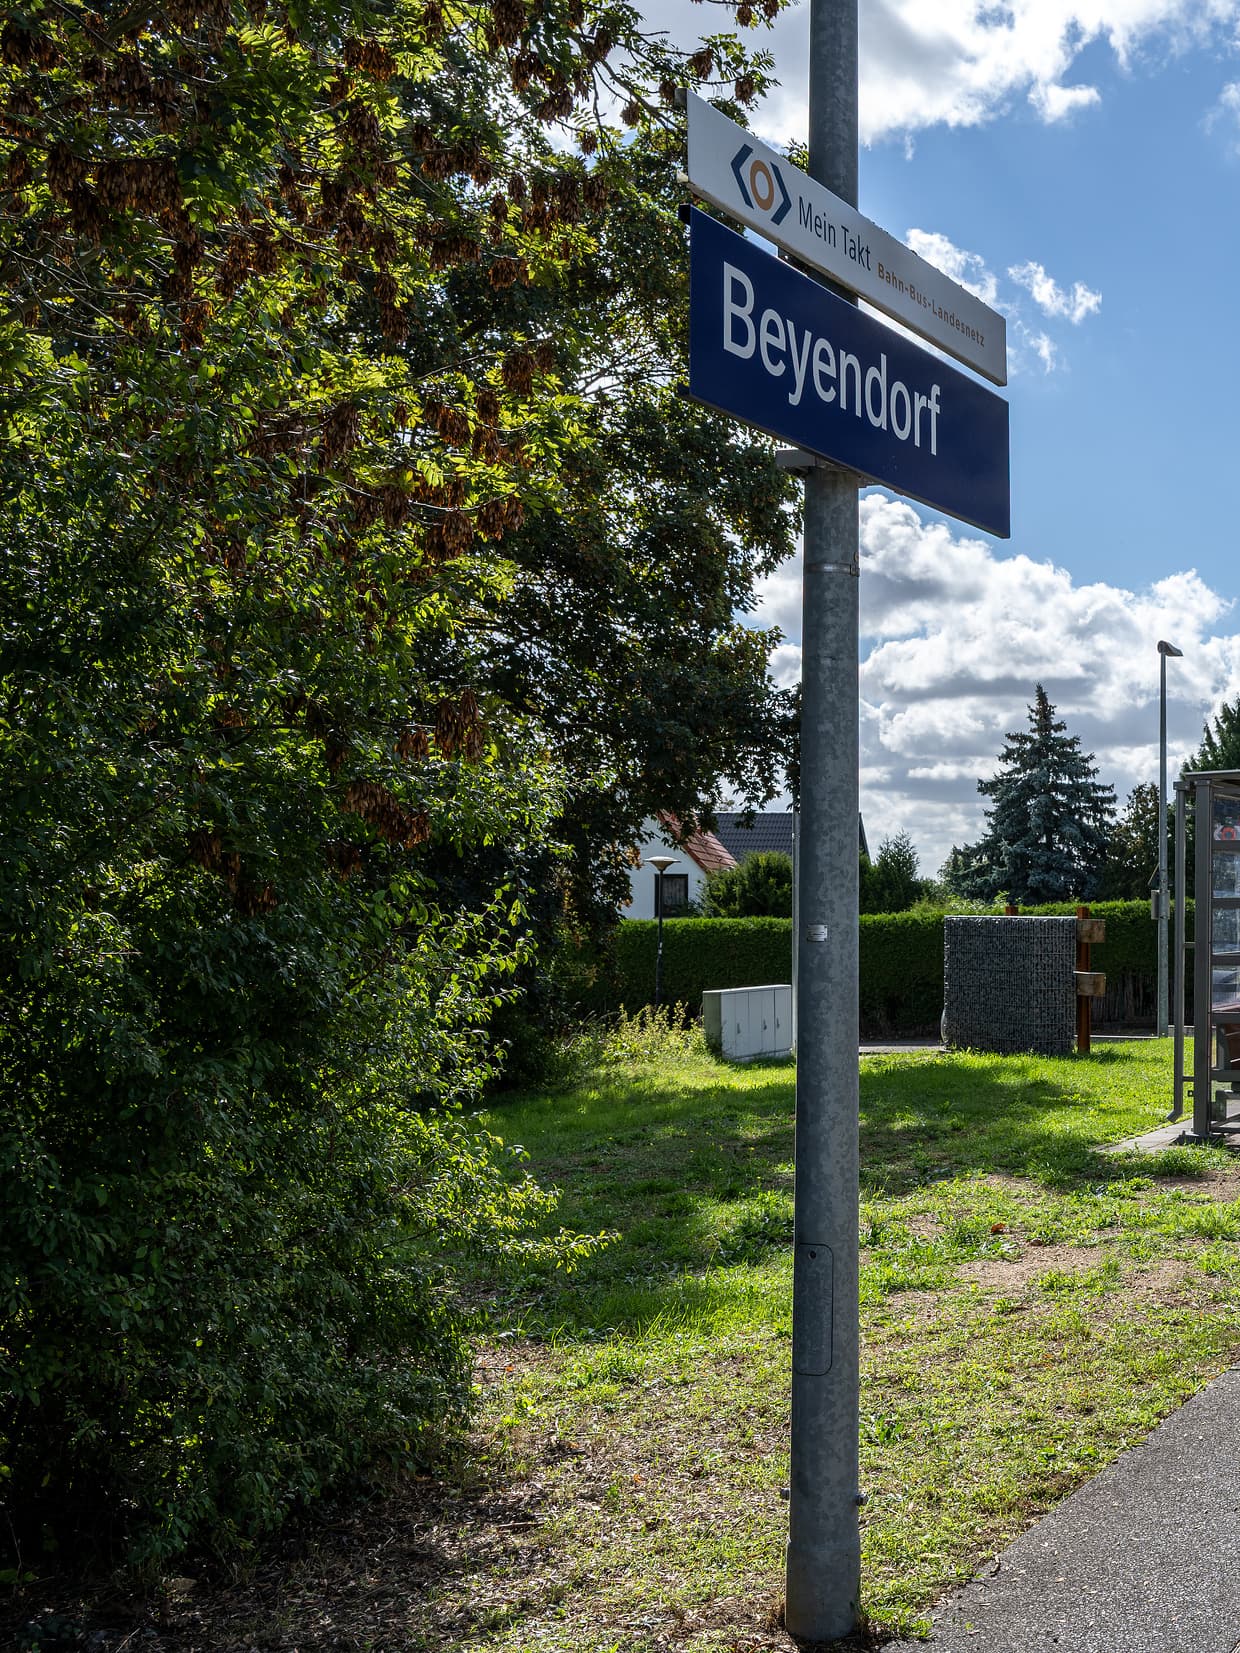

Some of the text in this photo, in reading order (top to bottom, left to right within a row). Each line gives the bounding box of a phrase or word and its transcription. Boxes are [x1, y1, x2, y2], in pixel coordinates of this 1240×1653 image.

[798, 196, 985, 347] Mein Takt Bahn-Bus-Landesnetz
[723, 261, 941, 456] Beyendorf
